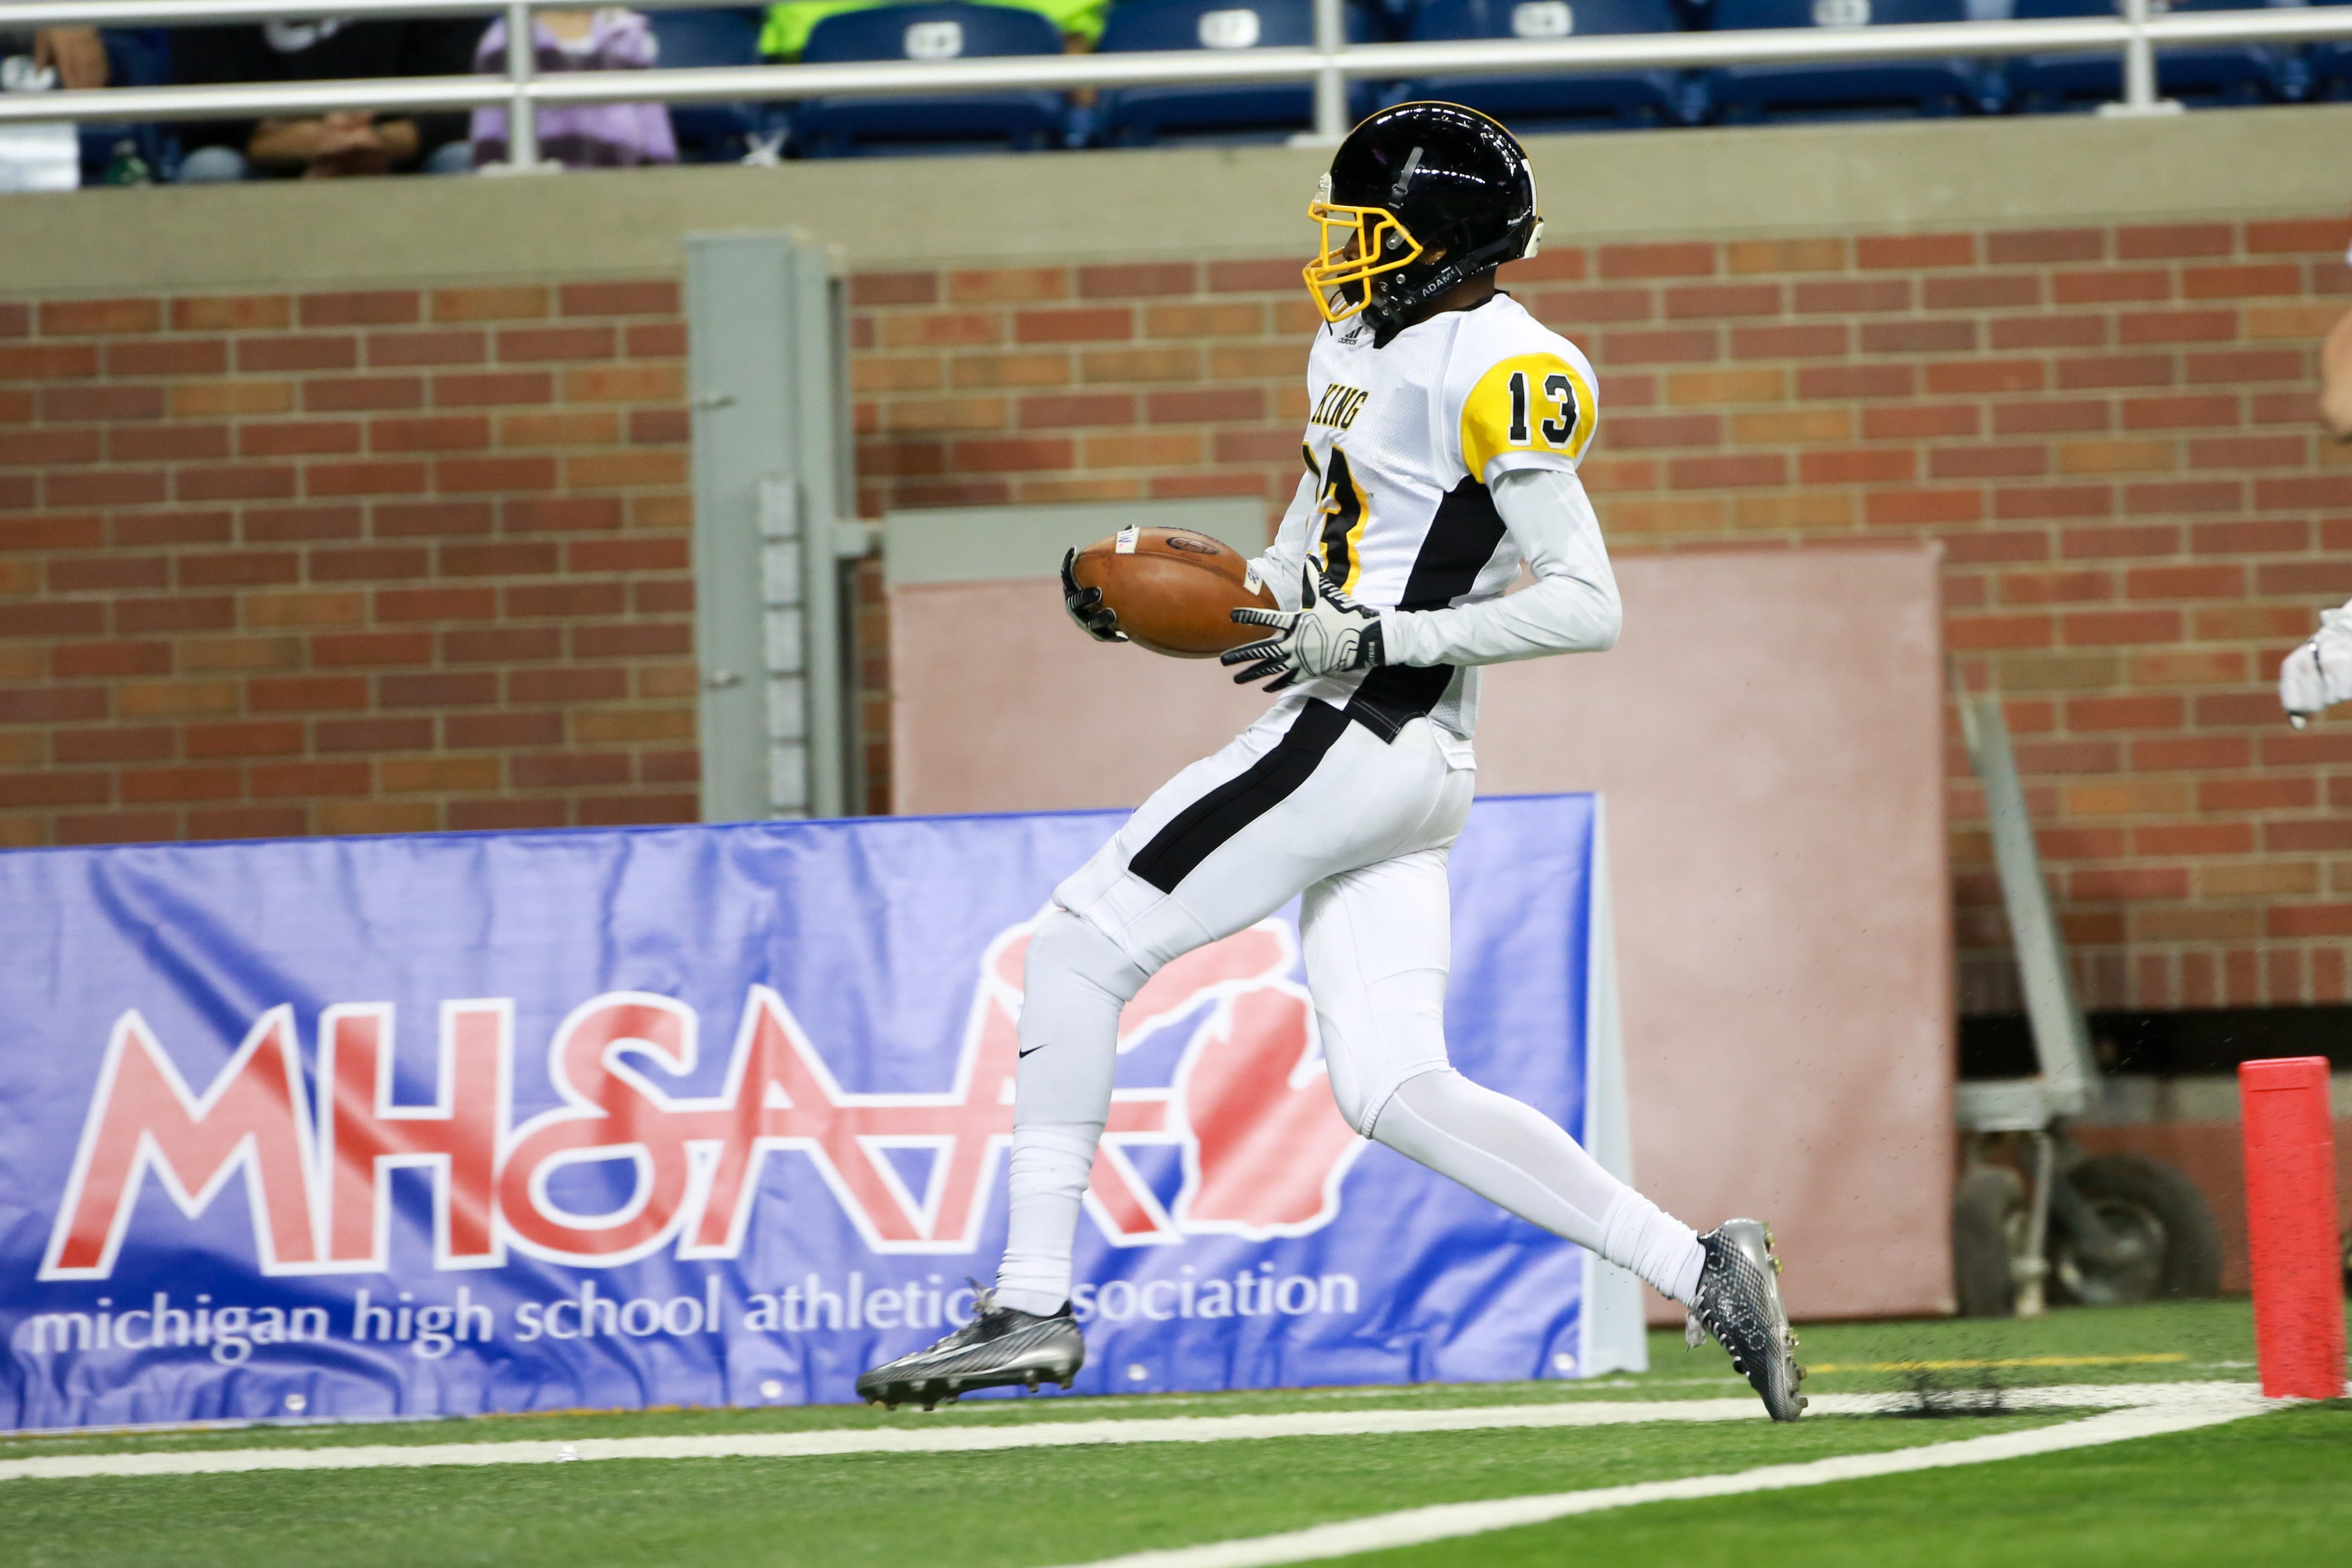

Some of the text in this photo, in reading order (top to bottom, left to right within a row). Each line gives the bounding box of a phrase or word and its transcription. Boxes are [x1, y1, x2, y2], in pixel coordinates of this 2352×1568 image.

[1311, 382, 1369, 431] KING
[1507, 371, 1581, 450] 13
[1302, 441, 1370, 597] 3
[31, 1261, 1358, 1367] michigan high school athletic sociation
